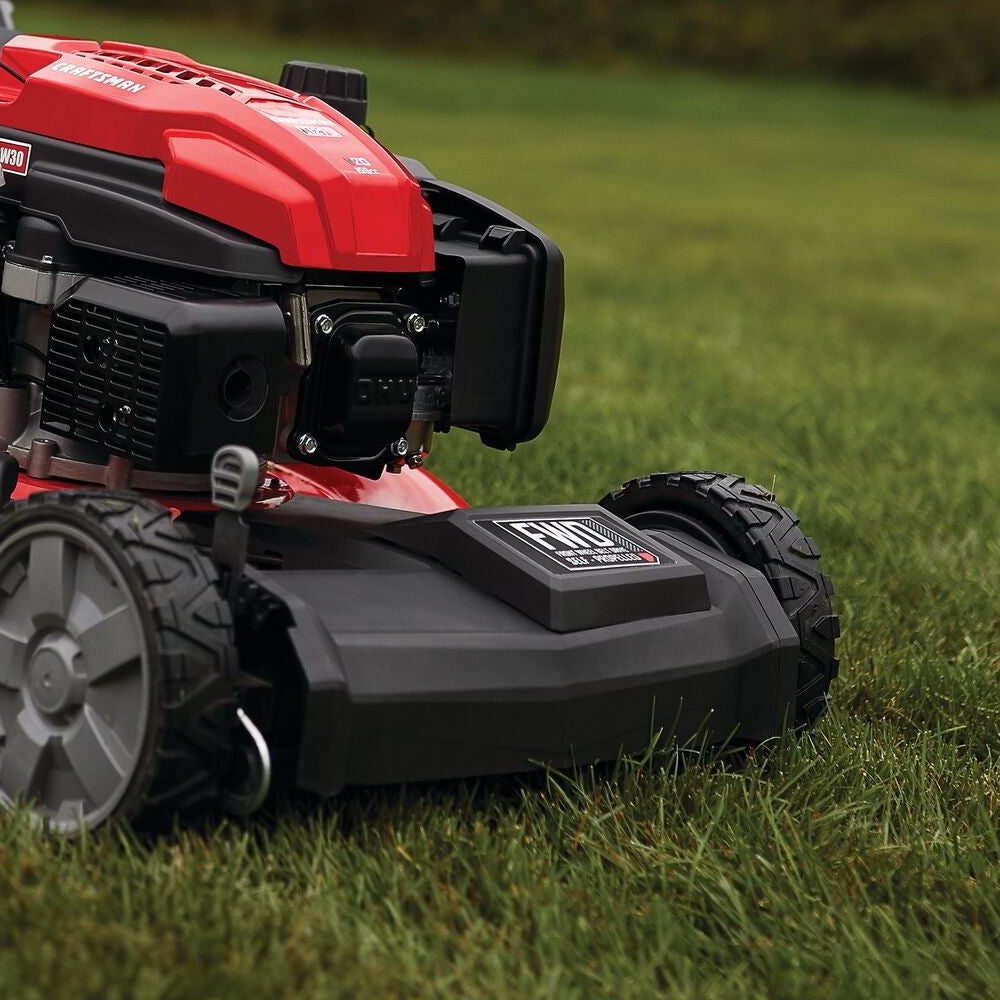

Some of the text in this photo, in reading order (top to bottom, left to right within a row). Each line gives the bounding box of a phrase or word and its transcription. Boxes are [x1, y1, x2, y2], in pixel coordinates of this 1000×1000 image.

[51, 62, 146, 94] CRAFTSMAN
[508, 520, 615, 551] FWD
[565, 556, 590, 566] SELF
[592, 553, 642, 564] PROPELLED
